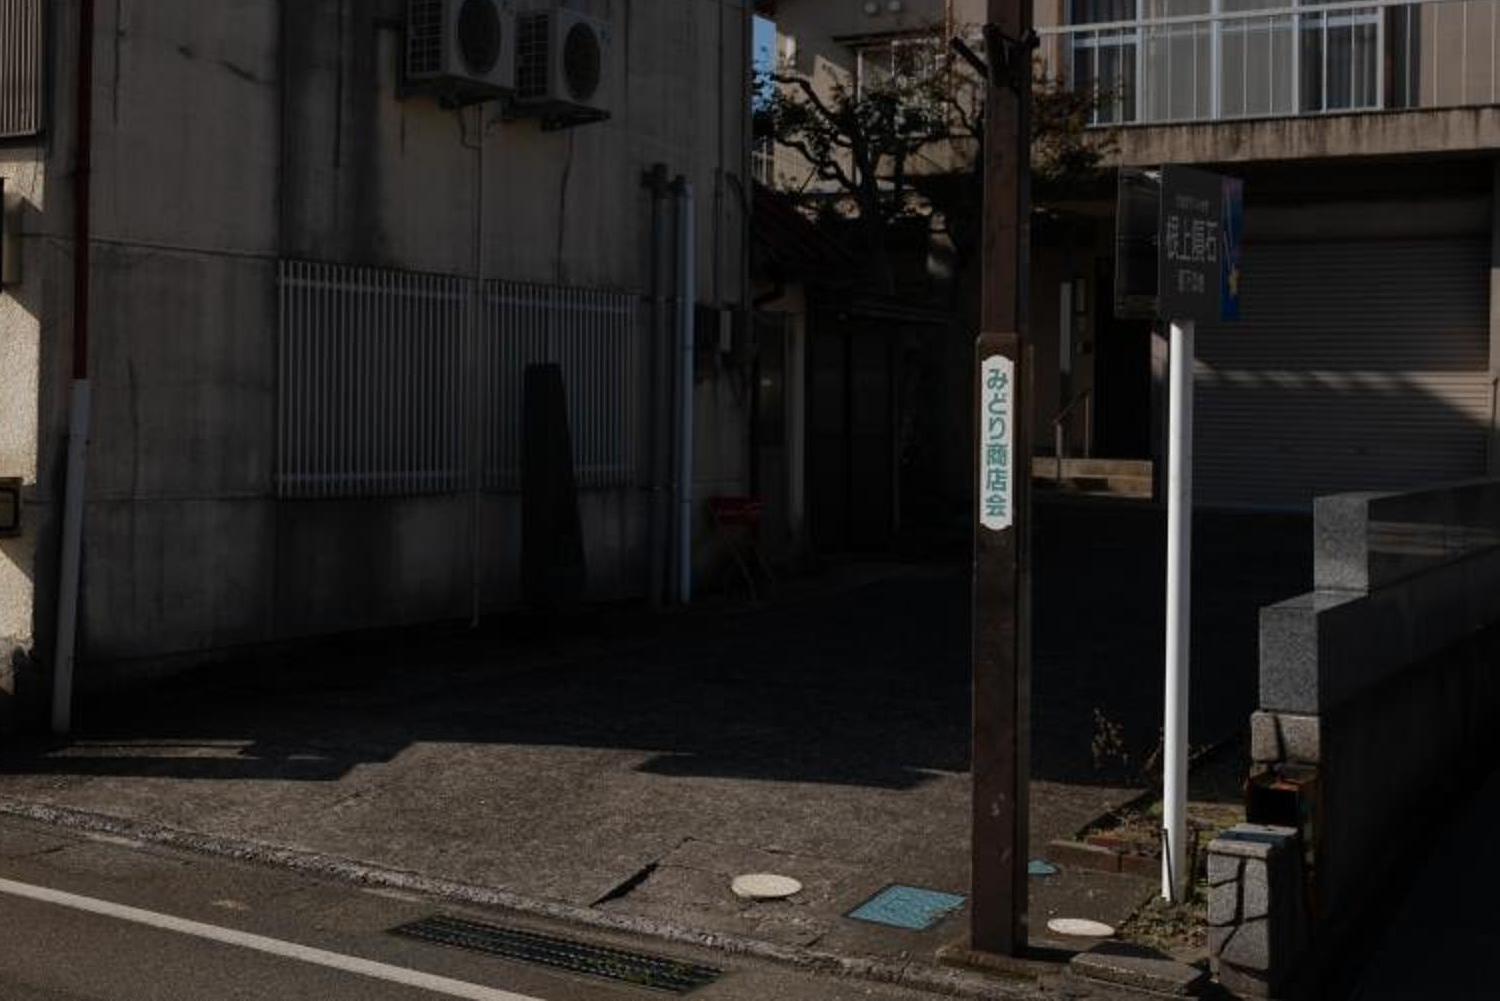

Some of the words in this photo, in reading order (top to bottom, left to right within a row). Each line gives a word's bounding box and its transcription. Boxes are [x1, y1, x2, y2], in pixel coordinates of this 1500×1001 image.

[986, 368, 1008, 518] みどり商店会
